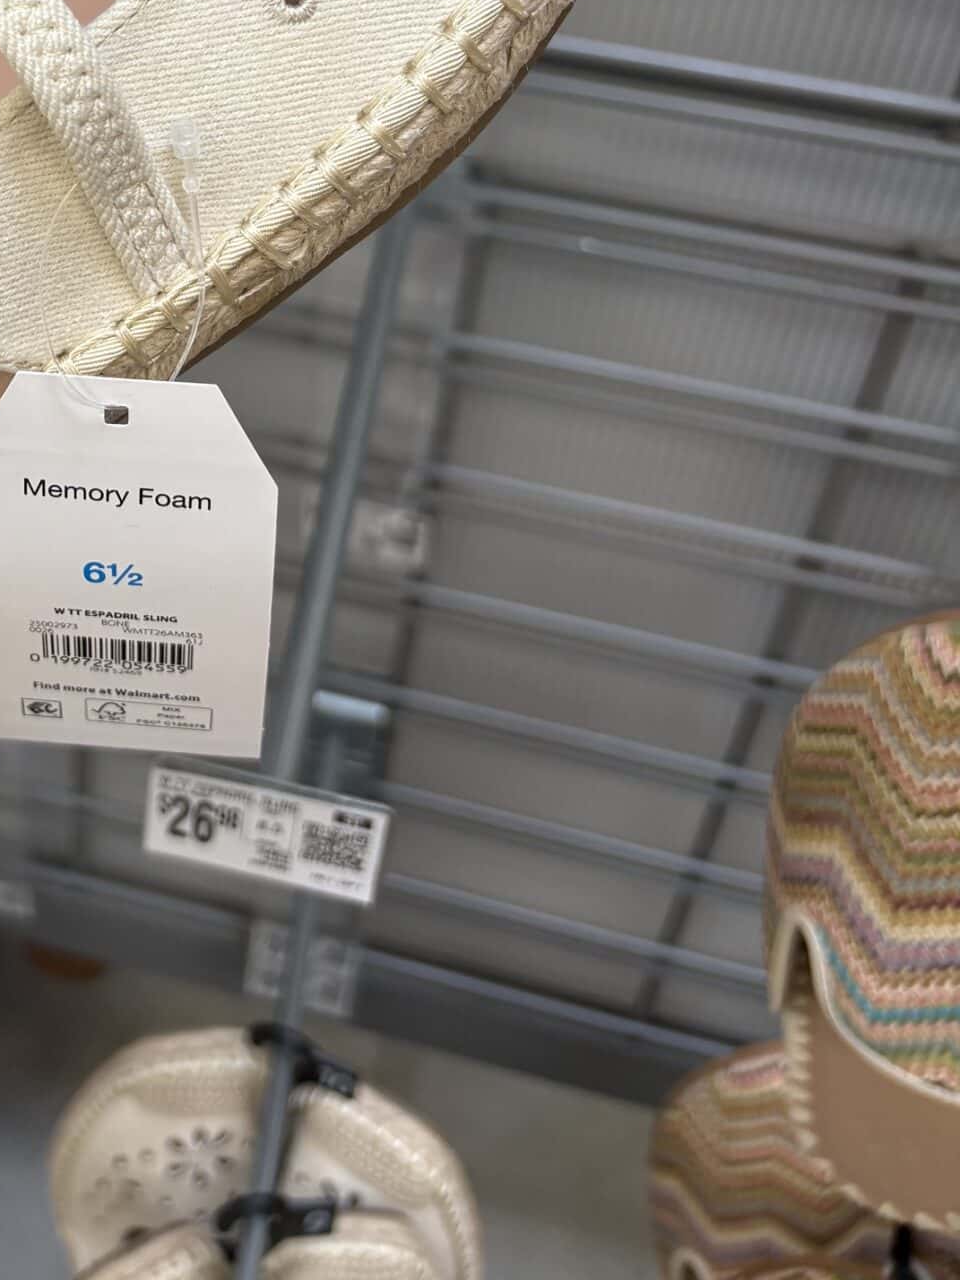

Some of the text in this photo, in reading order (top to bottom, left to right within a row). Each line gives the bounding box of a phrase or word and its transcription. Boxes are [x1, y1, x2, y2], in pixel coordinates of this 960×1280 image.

[22, 477, 213, 511] Memory Foam
[53, 607, 178, 623] W TT ESPADRIL SLING
[101, 619, 131, 628] BONE
[29, 652, 41, 663] 0
[50, 655, 115, 669] 199722
[33, 680, 202, 703] Find more at Walmart.com
